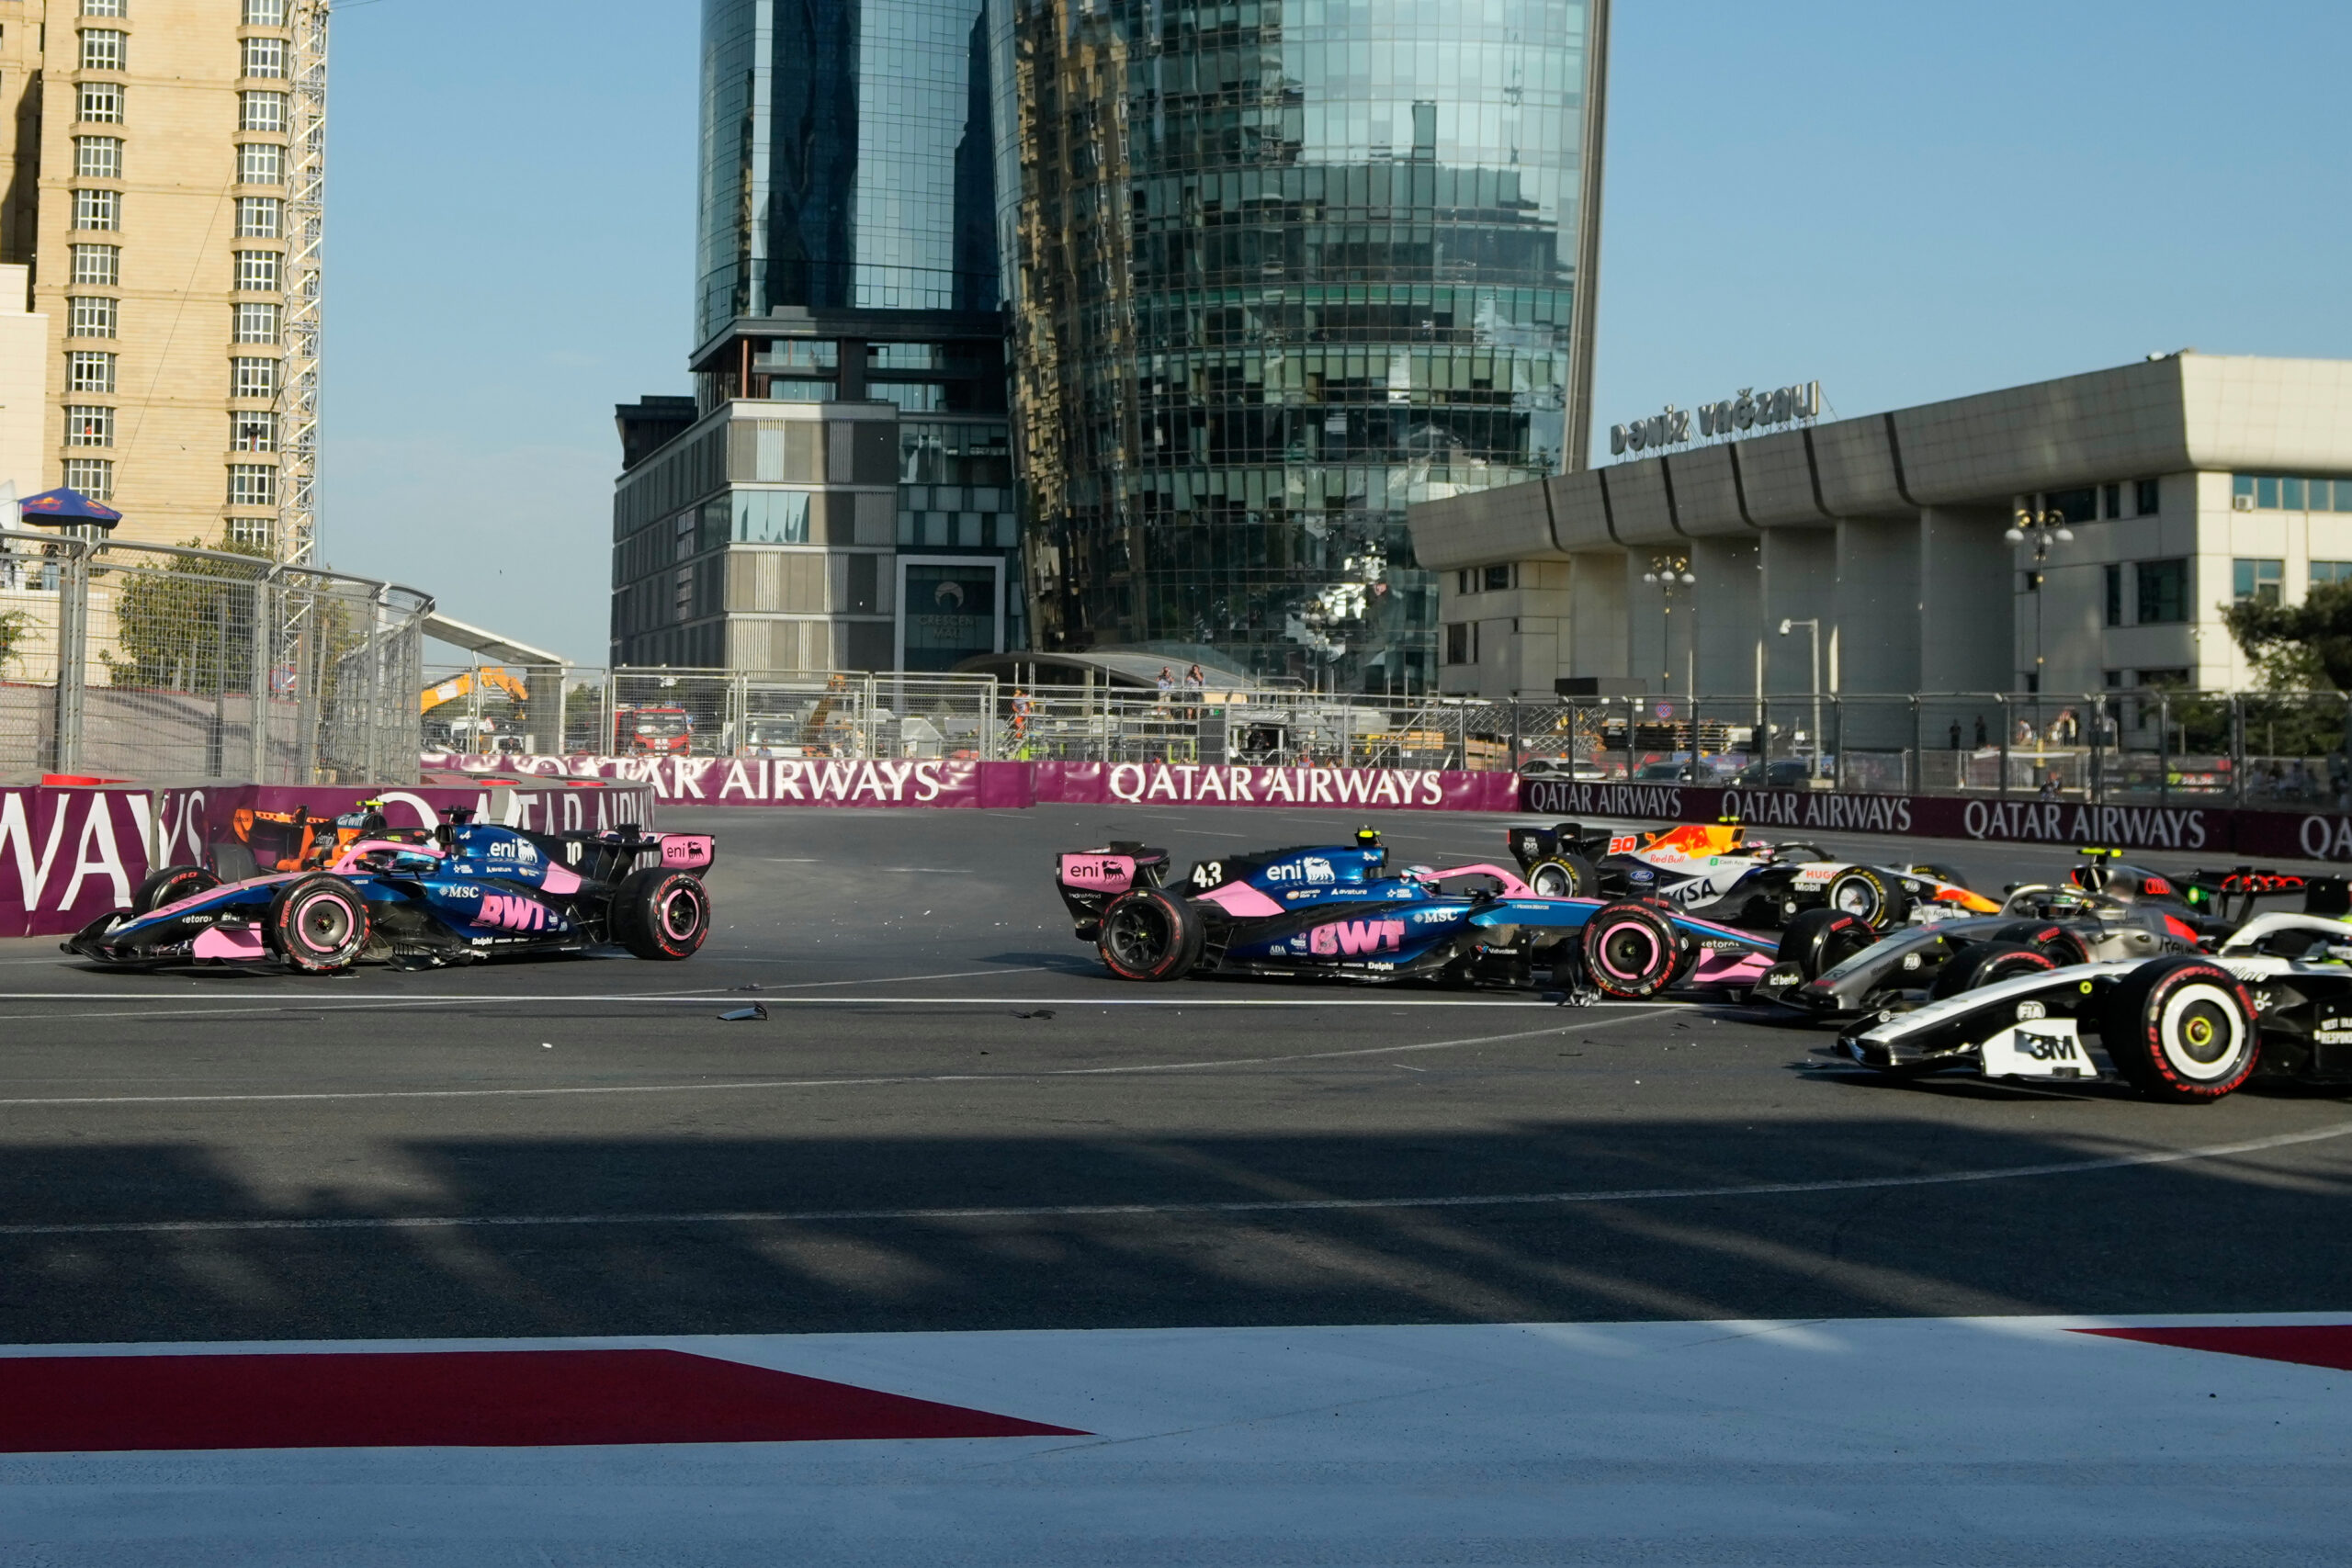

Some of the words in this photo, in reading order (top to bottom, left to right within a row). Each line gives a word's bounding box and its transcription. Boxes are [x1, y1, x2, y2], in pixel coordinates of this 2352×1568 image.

[1698, 380, 1818, 436] VAĞZALI
[718, 759, 941, 801] AIRWAYS
[1109, 763, 1254, 803] QATAR
[1266, 767, 1443, 806] AIRWAYS
[1531, 782, 1593, 813] QATAR
[1598, 784, 1682, 818] AIRWAYS
[1722, 790, 1799, 826] QATAR
[1804, 794, 1912, 831] AIRWAYS
[1963, 800, 2063, 840] QATAR
[2070, 805, 2206, 849] AIRWAYS
[490, 839, 516, 858] eni
[565, 841, 582, 866] 10
[666, 842, 685, 858] eni
[1609, 836, 1637, 854] 30
[1649, 853, 1668, 863] Red
[1668, 852, 1686, 863] Bull
[1069, 862, 1099, 877] eni
[1192, 862, 1222, 888] 43
[1266, 859, 1302, 881] eni
[448, 885, 480, 898] MSC
[1793, 882, 1821, 892] Mobil
[477, 895, 545, 931] BWT
[1424, 911, 1458, 923] MSC
[471, 936, 493, 946] Delphi
[1310, 920, 1406, 955] BWT
[1367, 962, 1395, 971] Delphi
[1905, 955, 1920, 967] FIA
[2020, 1003, 2044, 1017] FIA
[2029, 1035, 2078, 1061] 3M
